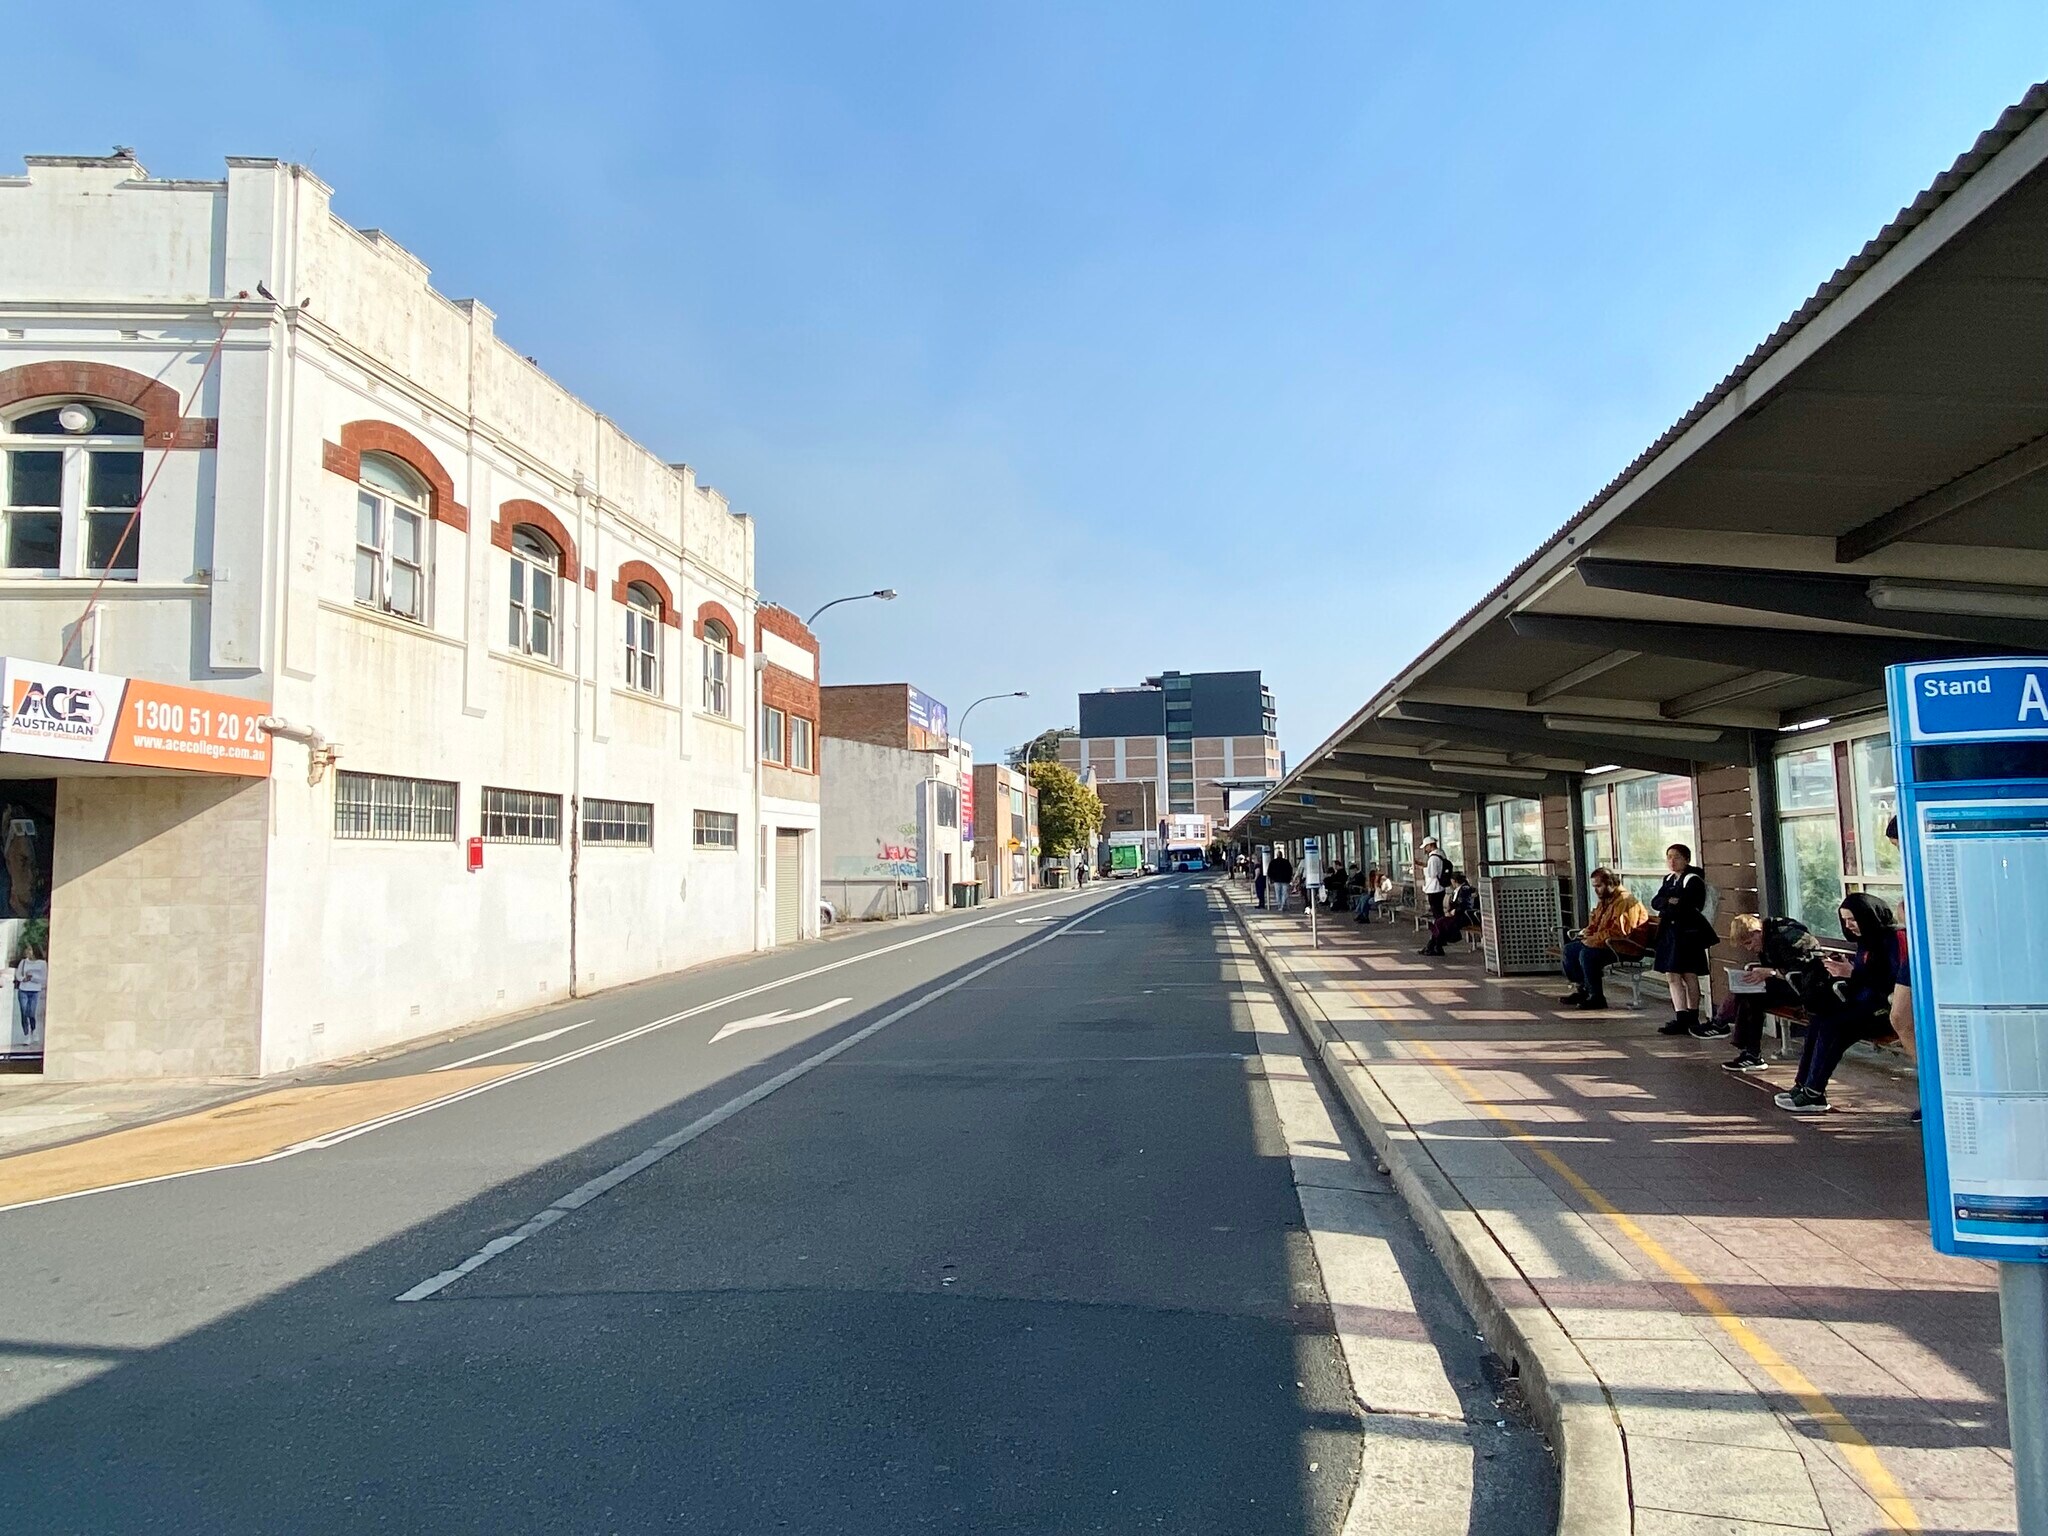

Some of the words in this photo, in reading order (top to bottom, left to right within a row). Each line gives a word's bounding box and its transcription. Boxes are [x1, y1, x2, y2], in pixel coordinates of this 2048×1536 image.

[18, 682, 91, 723] ACE
[1924, 676, 1991, 697] Stand
[2018, 674, 2048, 721] A
[10, 727, 42, 737] COLLEGE
[53, 732, 94, 743] EXCELLENCE
[12, 717, 94, 736] AUSTRALIAN
[133, 698, 184, 733] 1300
[189, 707, 211, 737] 51
[217, 711, 240, 741] 20
[133, 734, 266, 762] www.acecollege.com.au
